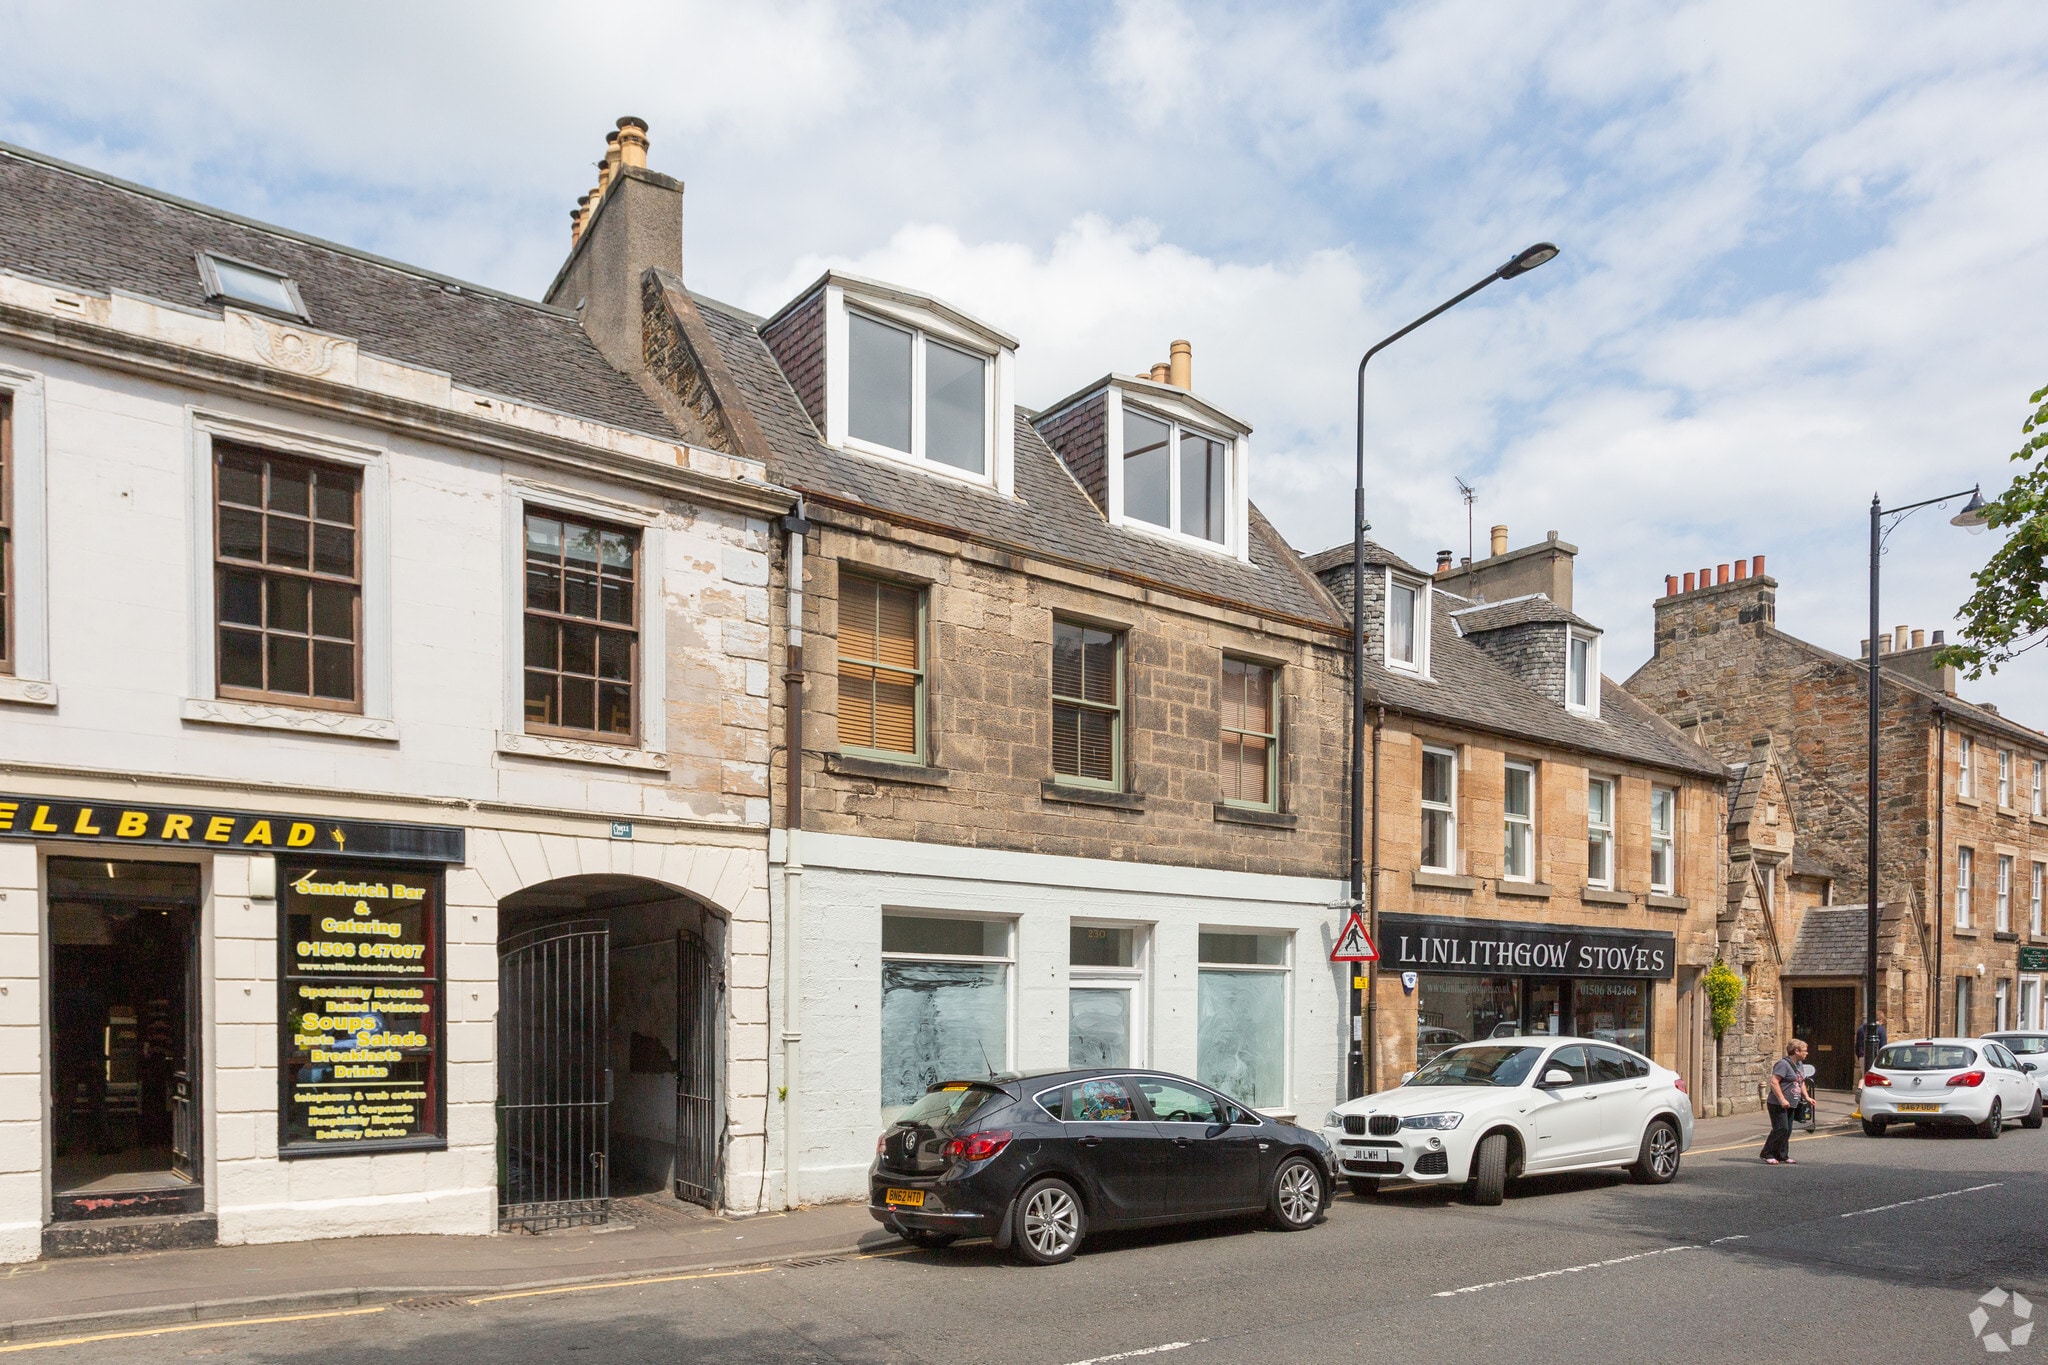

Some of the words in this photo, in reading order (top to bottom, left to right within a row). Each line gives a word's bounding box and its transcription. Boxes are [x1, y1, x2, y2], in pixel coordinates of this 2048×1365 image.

[296, 880, 388, 898] Sandwich
[392, 885, 425, 900] Bar
[354, 901, 371, 916] &
[321, 918, 401, 937] Catering
[1088, 929, 1106, 938] 230
[297, 942, 356, 957] 01506
[359, 943, 425, 959] 847007
[1399, 936, 1571, 968] LINLITHGOW
[1578, 944, 1665, 972] STOVES
[299, 986, 372, 999] Speciality
[374, 987, 424, 998] Breads
[1580, 985, 1605, 995] 01506
[1607, 985, 1637, 996] 842464
[326, 1002, 369, 1013] Baked
[371, 1001, 430, 1013] Potatoes
[302, 1013, 376, 1033] Soups
[295, 1034, 335, 1046] Pasta
[356, 1032, 427, 1047] Salads
[311, 1050, 402, 1062] Breakfasts
[334, 1065, 388, 1078] Drinks
[294, 1092, 352, 1103] telephone
[353, 1091, 363, 1101] &
[365, 1091, 389, 1101] web
[391, 1090, 427, 1100] orders
[309, 1105, 344, 1115] Buffet
[347, 1105, 357, 1114] &
[358, 1104, 414, 1114] Corporate
[308, 1115, 370, 1127] Hospitality
[371, 1114, 415, 1125] Experts
[316, 1129, 363, 1140] Delivery
[364, 1128, 407, 1138] Service
[1363, 1151, 1379, 1160] LWH
[889, 1190, 907, 1202] BN62
[907, 1191, 921, 1203] HTD
